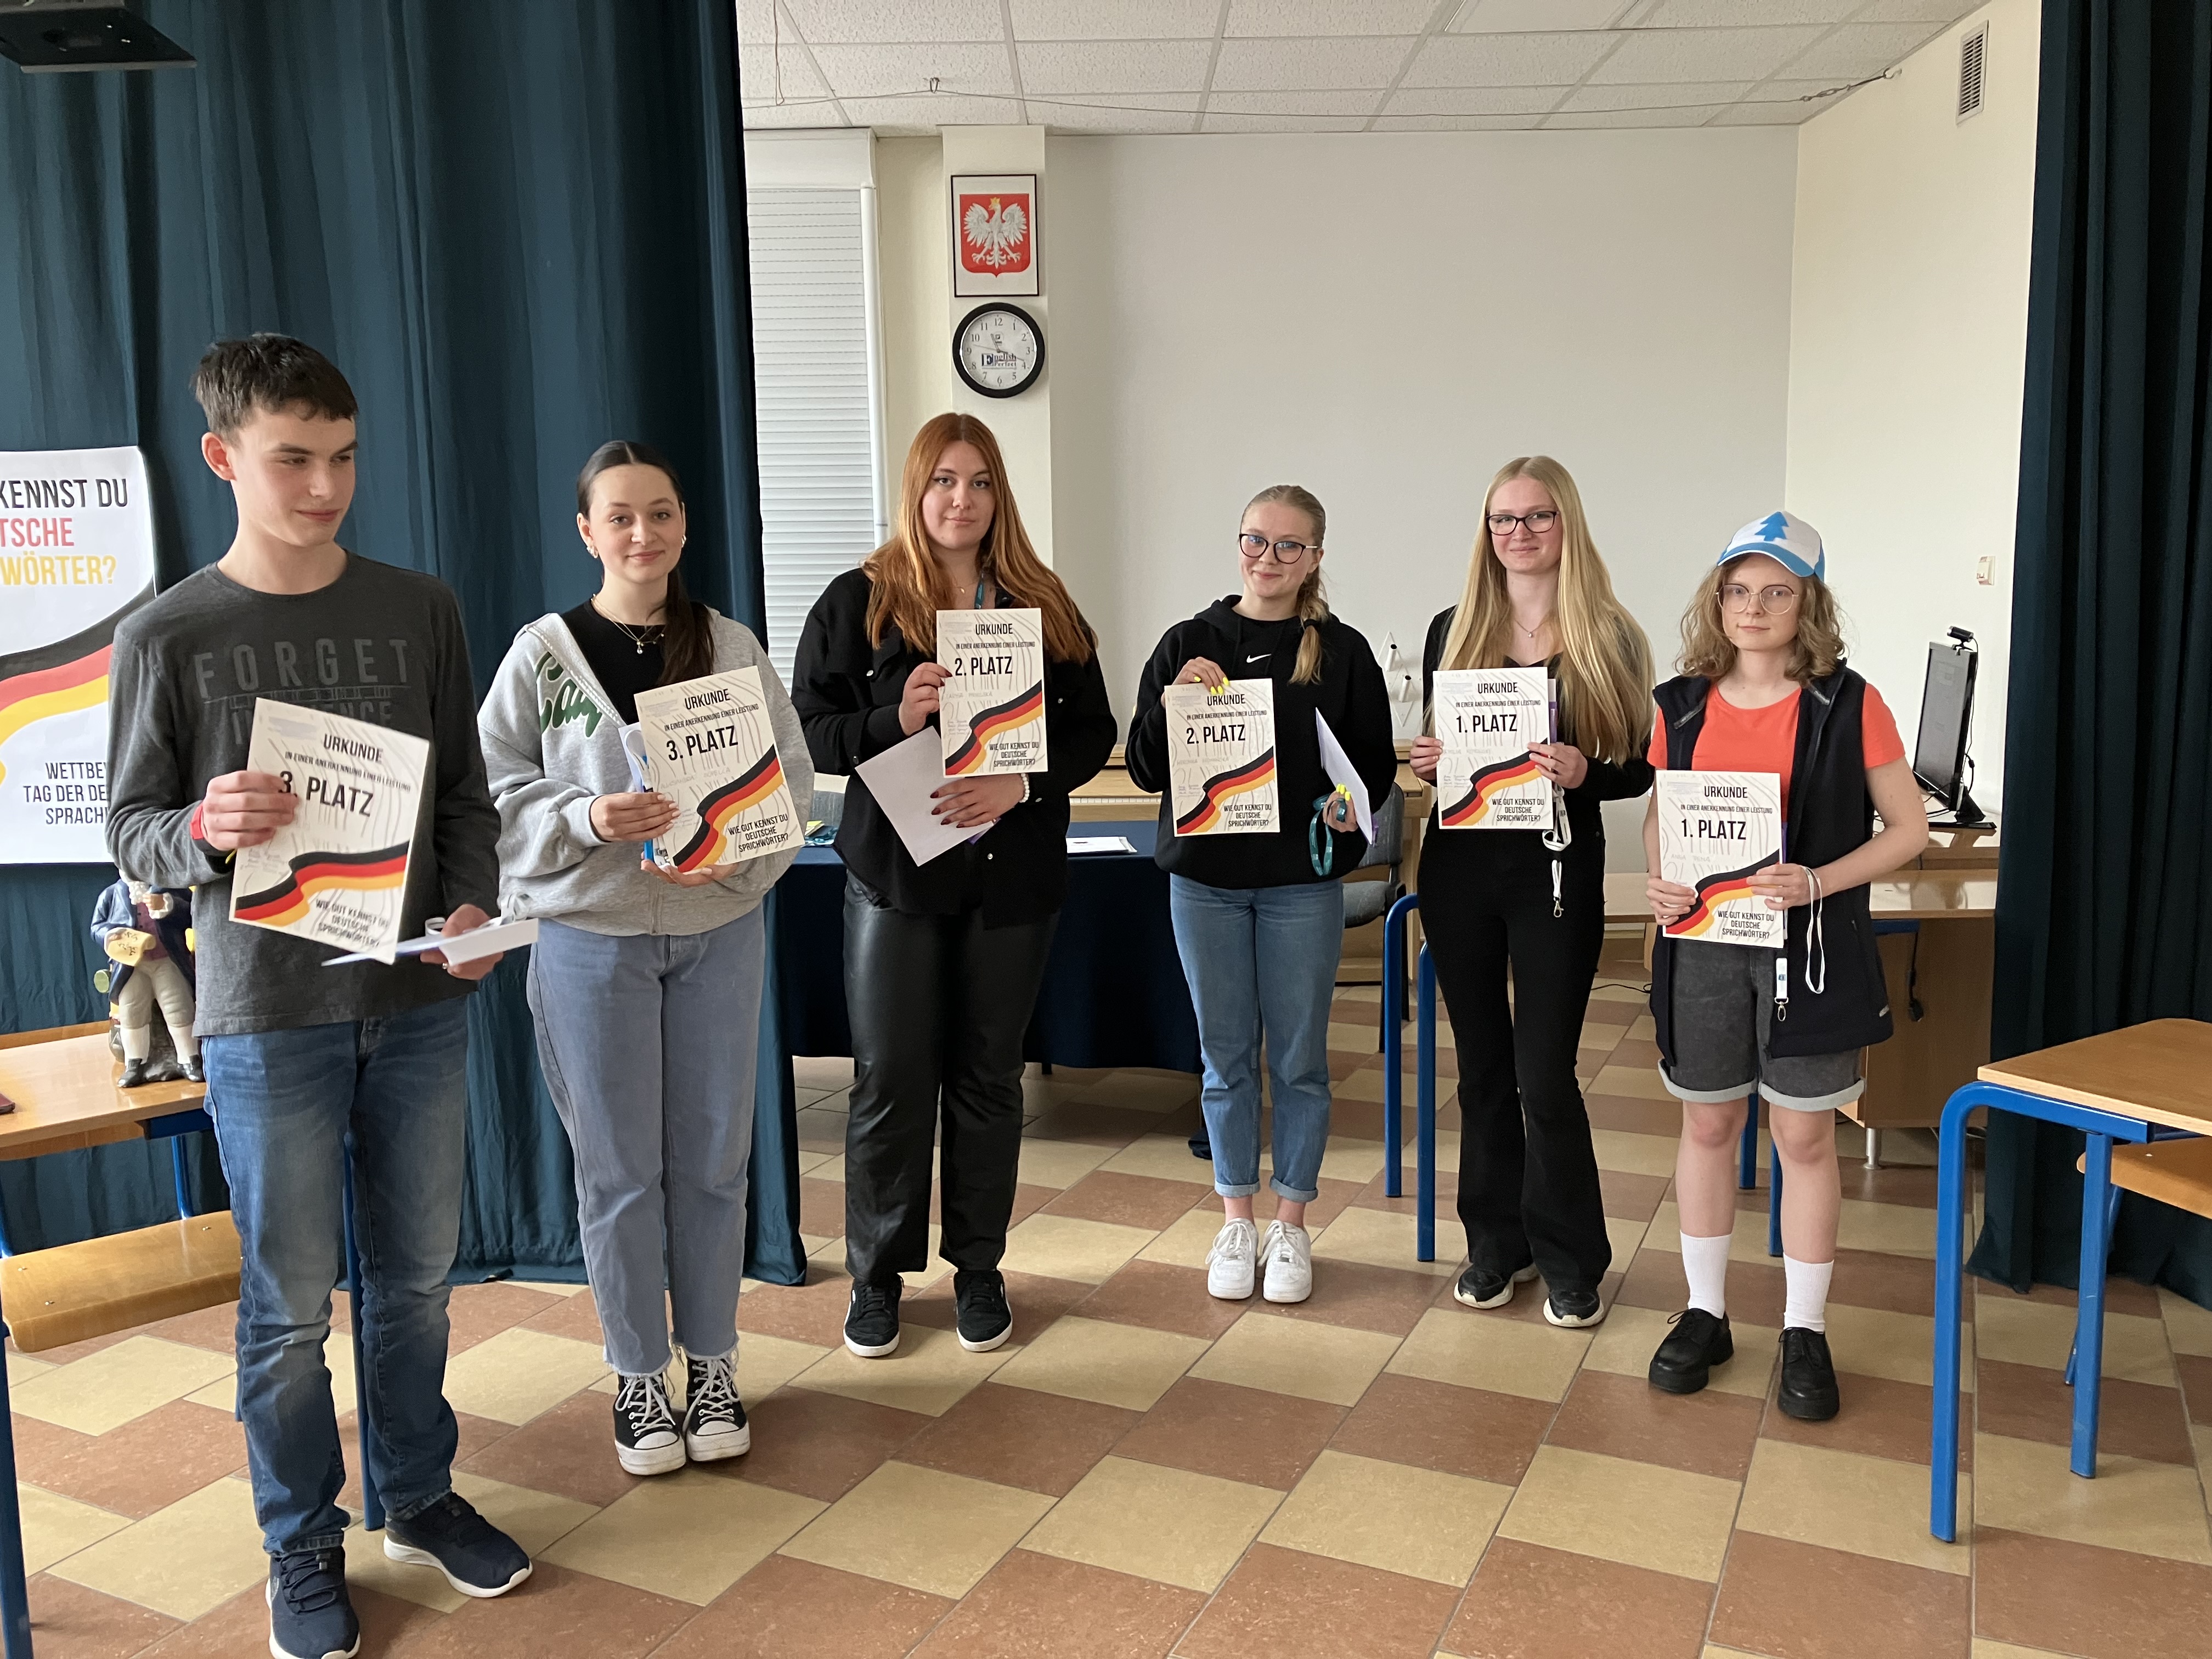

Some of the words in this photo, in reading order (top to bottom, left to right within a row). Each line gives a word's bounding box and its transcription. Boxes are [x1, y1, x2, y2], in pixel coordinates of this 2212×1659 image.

[1013, 322, 1015, 330] 1
[1026, 347, 1030, 355] 3
[95, 478, 128, 507] DU
[0, 551, 116, 585] WÖRTER?
[975, 623, 1013, 635] URKUNDE
[193, 638, 408, 699] FORGET
[955, 658, 966, 676] 2.
[971, 656, 1013, 675] PLATZ
[1477, 682, 1518, 694] URKUNDE
[684, 689, 730, 710] URKUNDE
[1207, 694, 1245, 706] URKUNDE
[664, 724, 669, 732] IN
[670, 720, 684, 731] EINER
[721, 708, 735, 718] EINER
[736, 703, 759, 715] LEISTUNG
[1456, 715, 1468, 733] 1.
[1472, 714, 1517, 732] PLATZ
[666, 740, 684, 761] 3.
[686, 725, 738, 756] PLATZ
[1187, 727, 1199, 744] 2.
[1203, 724, 1245, 743] PLATZ
[323, 733, 383, 763] URKUNDE
[46, 762, 105, 779] WETTBE
[23, 786, 51, 802] TAG
[56, 785, 84, 802] DER
[279, 771, 298, 798] 3.
[306, 776, 374, 817] PLATZ
[1704, 786, 1747, 798] URKUNDE
[728, 825, 741, 835] WIE
[741, 822, 753, 832] GUT
[754, 816, 778, 829] KENNST
[779, 813, 788, 822] DU
[1497, 814, 1541, 822] SPRICHWÖRTER?
[746, 826, 777, 841] DEUTSCHE
[1681, 819, 1693, 837] 1.
[1699, 820, 1746, 840] PLATZ
[738, 833, 789, 852] SPRICHWÖRTER?
[1731, 921, 1760, 929] DEUTSCHE
[1742, 912, 1765, 921] KENNST
[1722, 928, 1770, 939] SPRICHWÖRTER?
